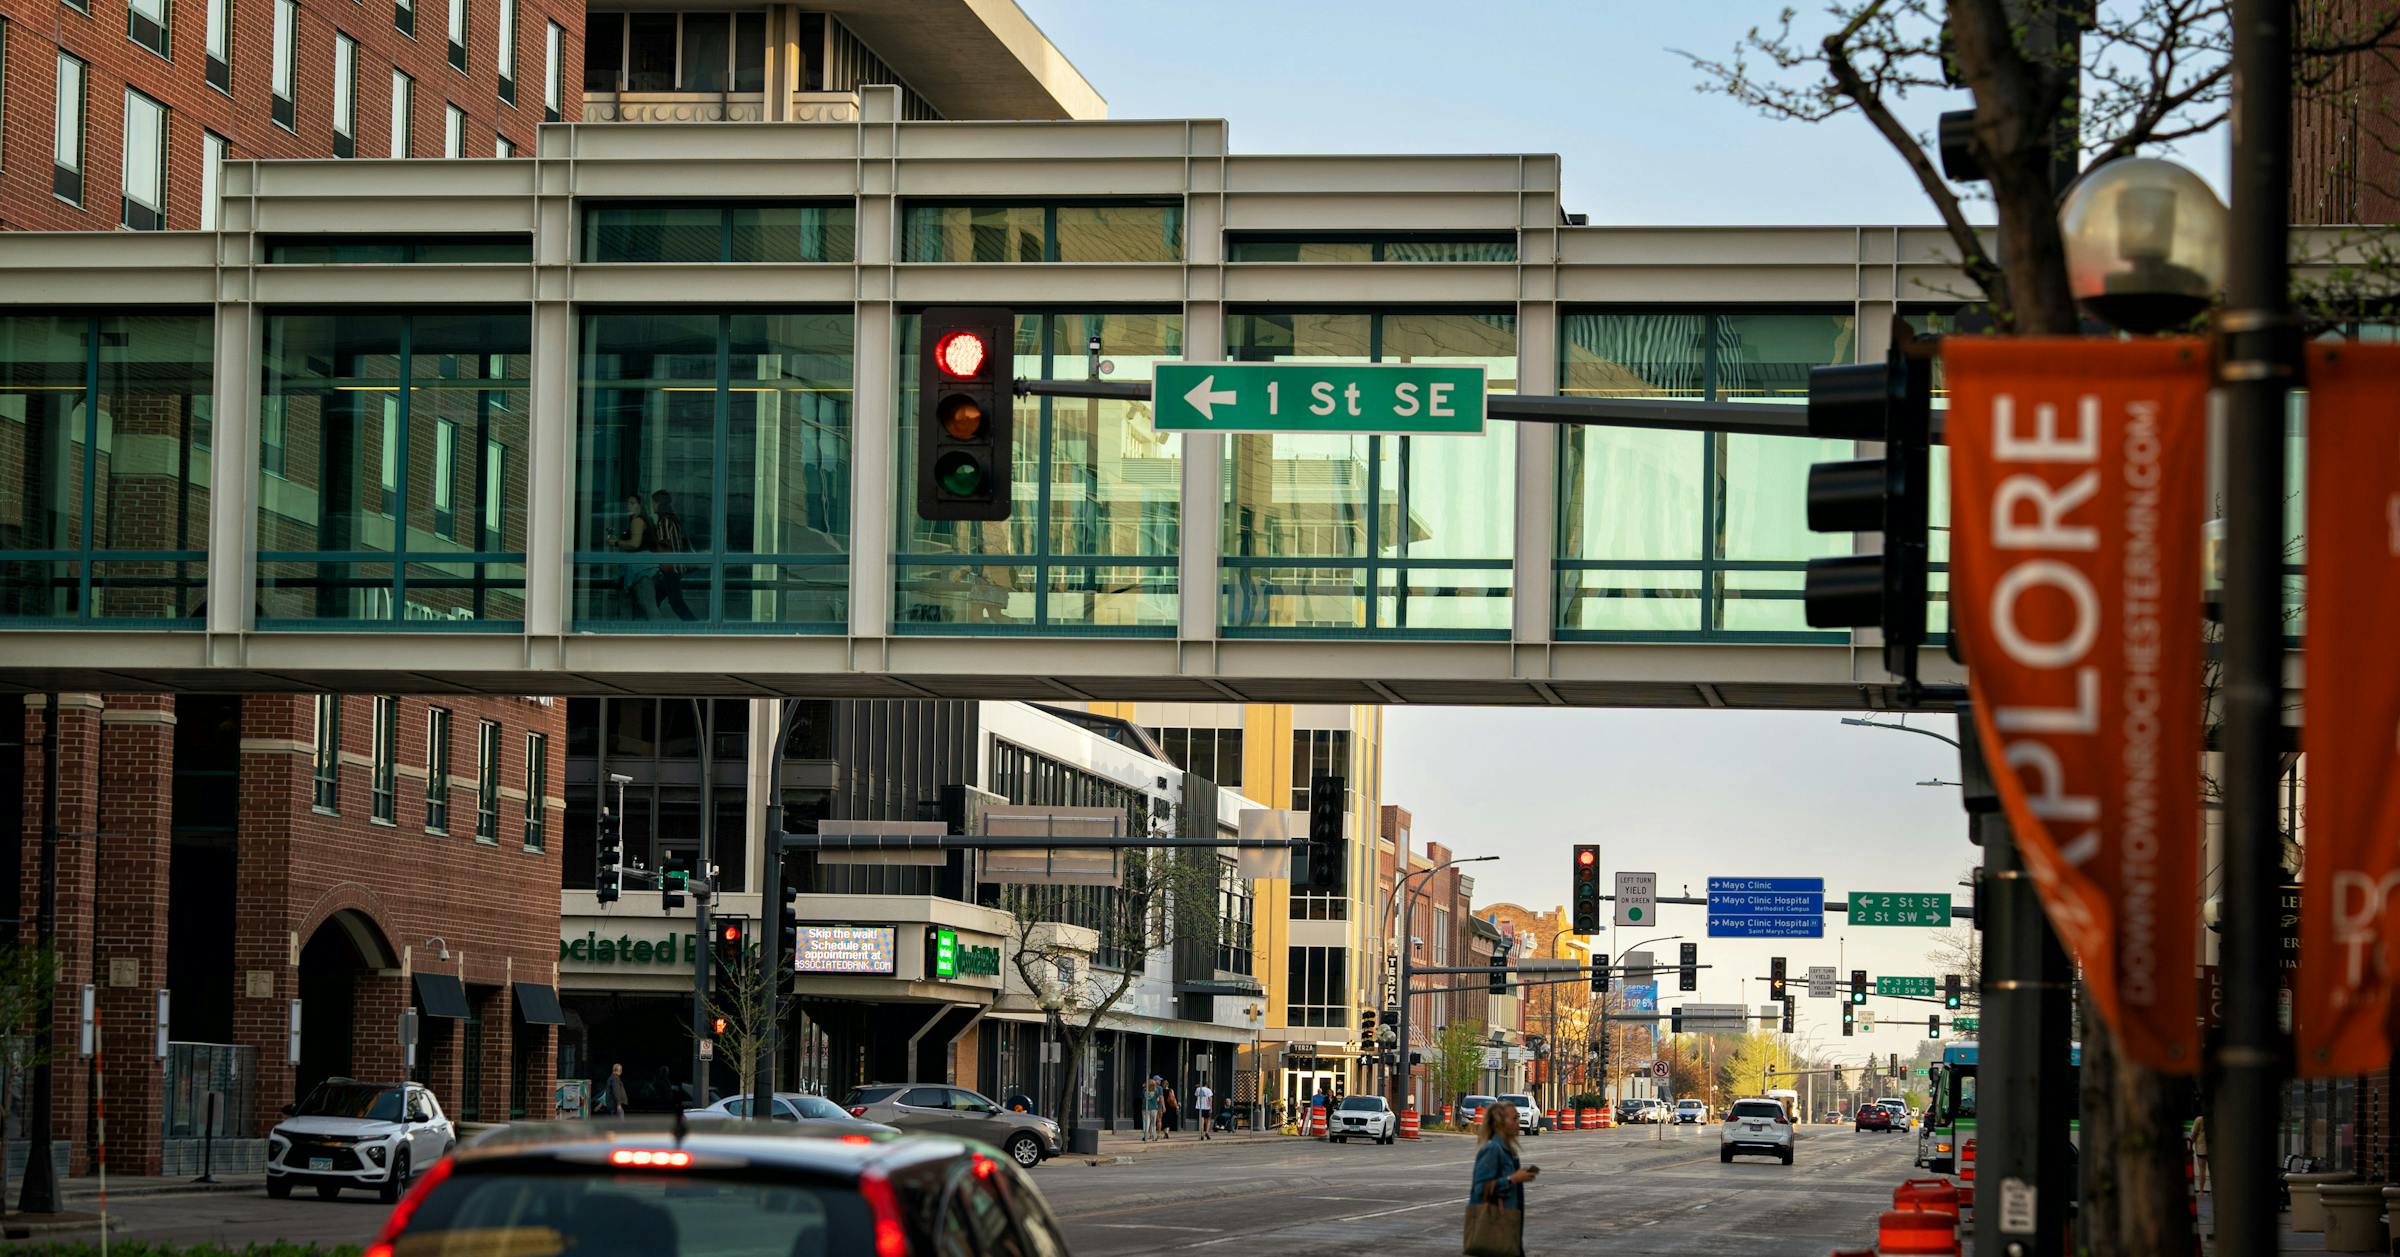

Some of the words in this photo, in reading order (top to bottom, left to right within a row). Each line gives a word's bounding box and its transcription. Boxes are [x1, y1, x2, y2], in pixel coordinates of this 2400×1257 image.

[1267, 381, 1279, 416] 1
[1309, 381, 1361, 417] St
[1393, 382, 1455, 417] SE
[1991, 394, 2100, 866] PLORE
[1625, 886, 1647, 895] YIELD
[1722, 881, 1745, 890] Mayo
[1747, 881, 1772, 889] Clinic
[1722, 896, 1745, 905] Mayo
[1747, 896, 1772, 904] Clinic
[1774, 896, 1810, 906] Hospital
[1881, 897, 1890, 908] 2
[1898, 897, 1913, 908] St
[1922, 897, 1940, 908] SE
[1857, 911, 1866, 922] 2
[1874, 911, 1889, 922] St
[1898, 911, 1918, 922] SW
[1722, 919, 1745, 928] Mayo
[1747, 919, 1772, 927] Clinic
[1774, 919, 1810, 929] Hospital
[808, 928, 832, 939] Skip
[833, 928, 850, 938] the
[852, 929, 877, 939] wait!
[811, 940, 859, 950] Schedule
[861, 942, 874, 951] an
[804, 950, 869, 961] appointment
[870, 951, 882, 960] at
[1388, 957, 1396, 1004] TERZA
[1895, 978, 1901, 986] 3
[1295, 1044, 1313, 1052] TERZA
